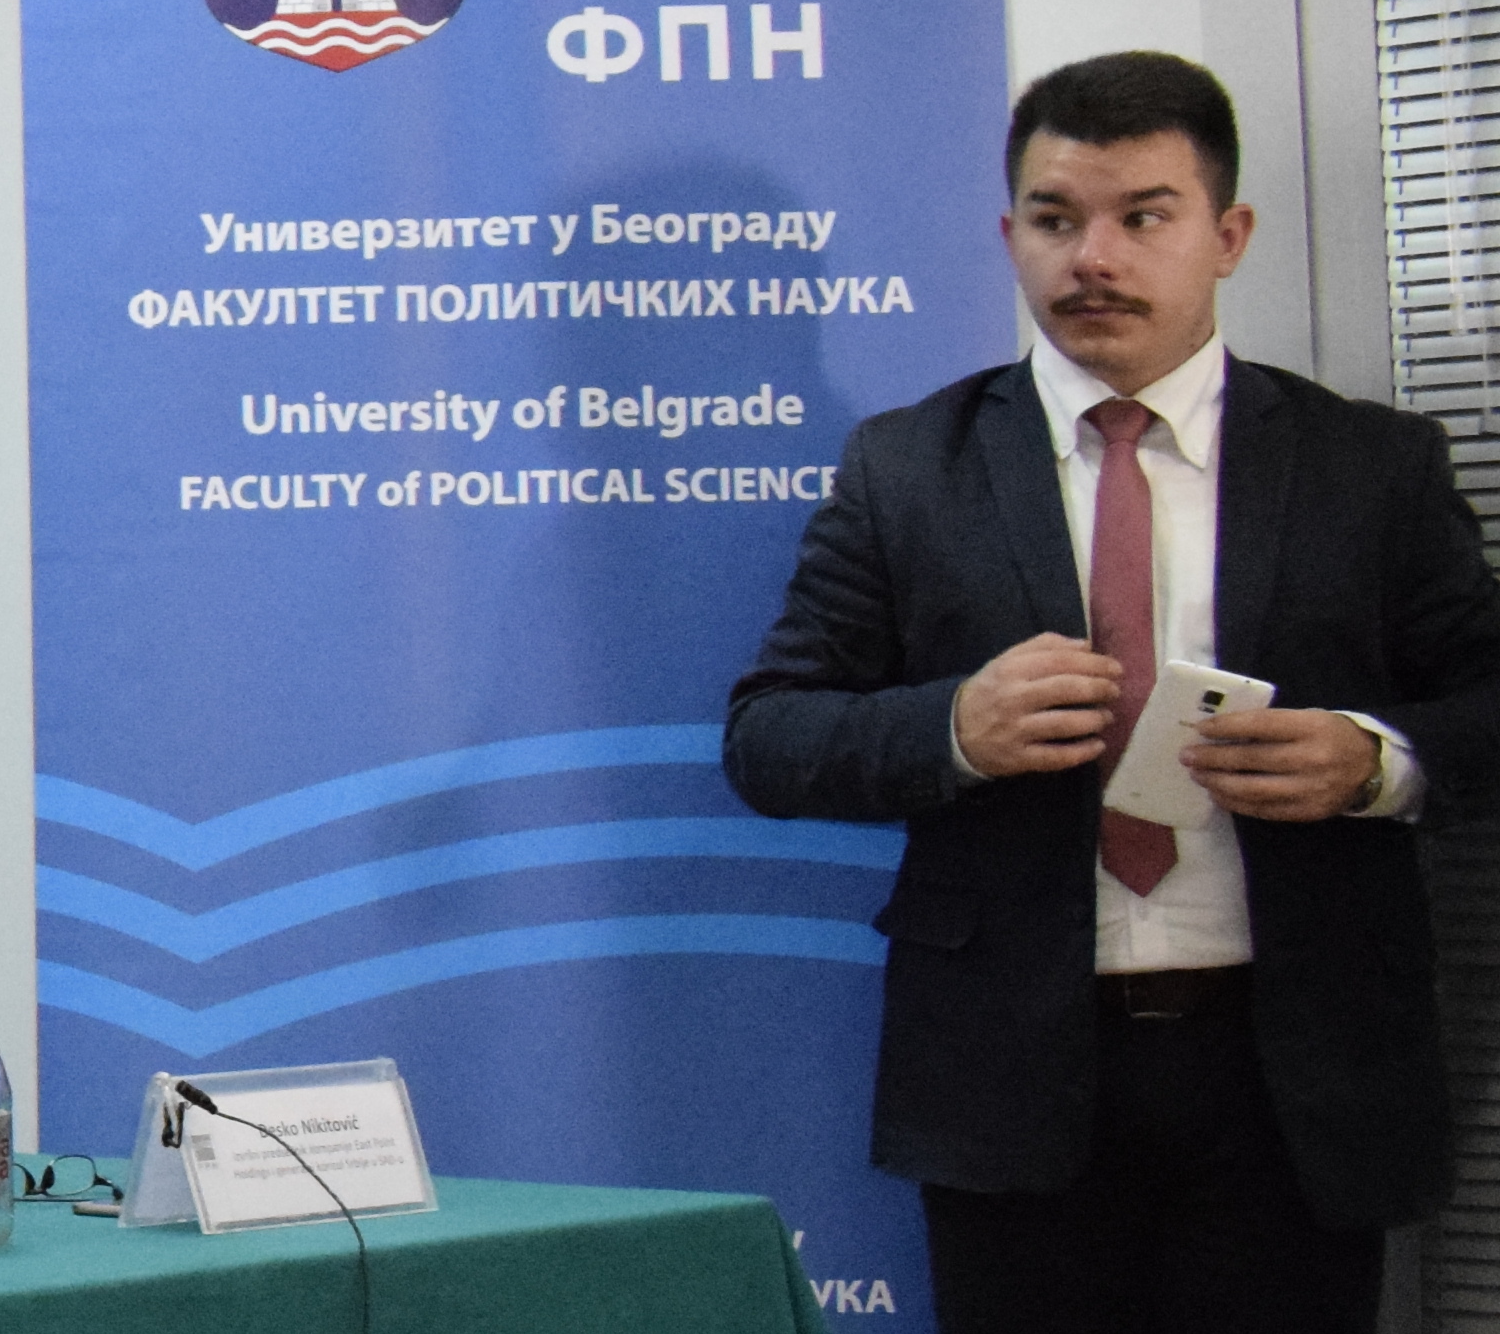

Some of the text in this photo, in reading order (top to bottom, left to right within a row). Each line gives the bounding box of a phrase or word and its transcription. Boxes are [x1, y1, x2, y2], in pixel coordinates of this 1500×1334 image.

[547, 3, 823, 81] ФПН
[201, 204, 836, 258] Универзитет у Београду
[128, 276, 914, 329] ФАКУЛТЕТ ПОЛИТИЧКИХ НАУКА
[241, 384, 804, 441] University of Belgrade
[180, 466, 837, 510] FACULTY of POLITICAL SCIENCE
